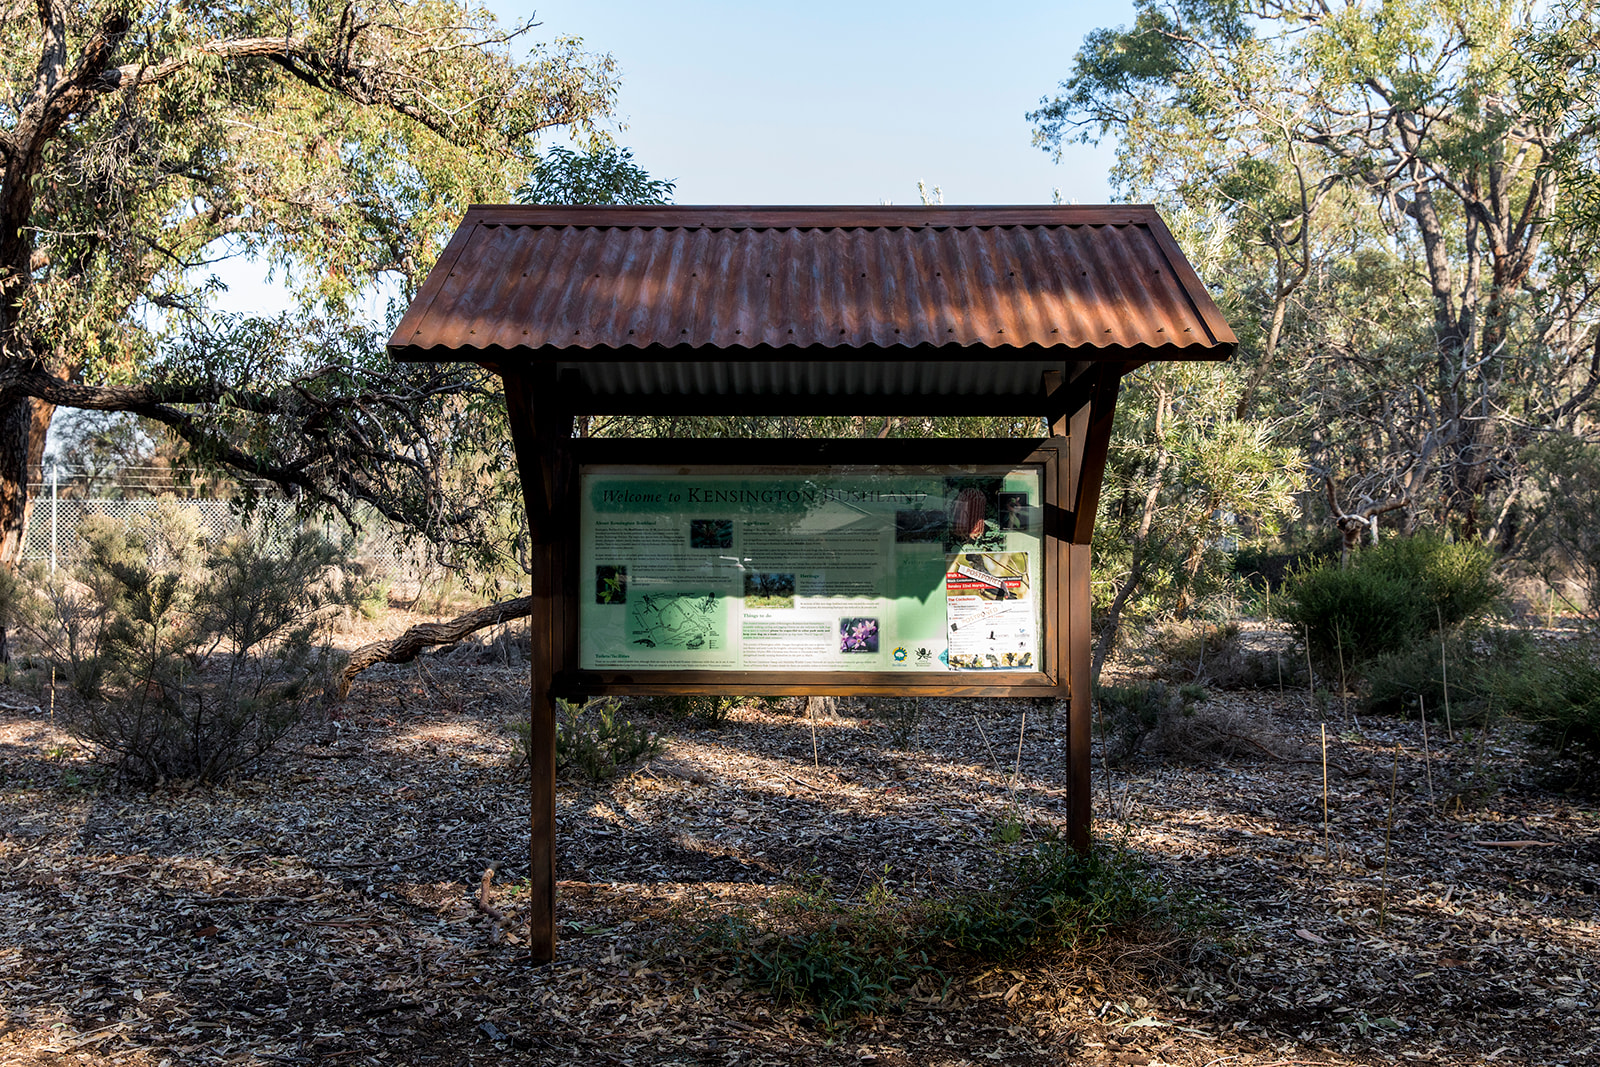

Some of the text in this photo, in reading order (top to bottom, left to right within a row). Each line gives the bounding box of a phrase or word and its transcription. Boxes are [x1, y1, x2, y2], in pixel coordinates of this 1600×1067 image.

[603, 487, 927, 503] Welcome to KENSINGTON BUSHLAND
[966, 568, 1002, 586] POSTPONED
[961, 606, 998, 624] POSTPONED
